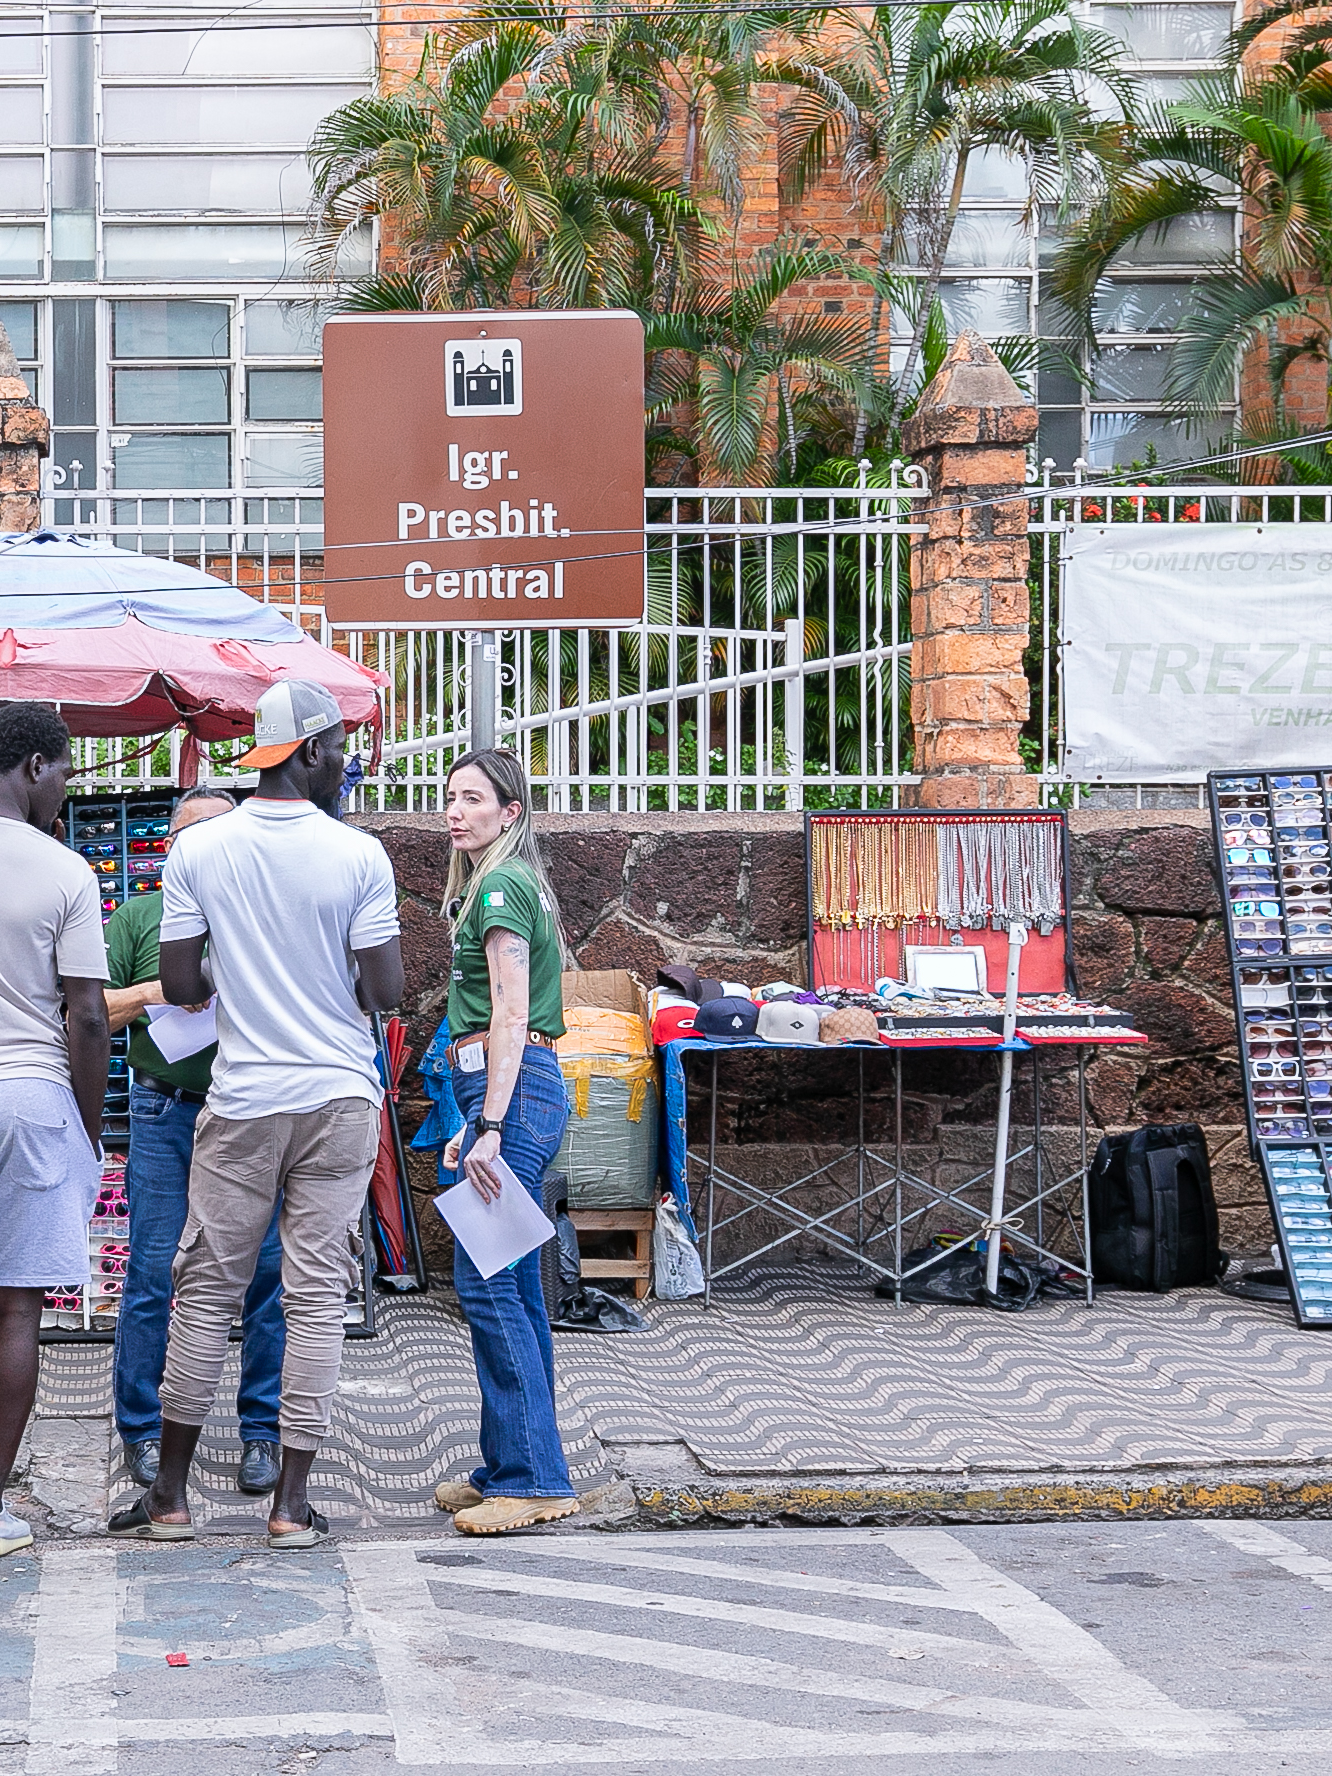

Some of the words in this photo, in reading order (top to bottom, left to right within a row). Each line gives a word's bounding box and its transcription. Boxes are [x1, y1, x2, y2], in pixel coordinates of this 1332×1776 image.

[448, 443, 519, 490] Igr.
[397, 499, 571, 540] Presbit.
[403, 560, 565, 599] Central
[1110, 552, 1258, 572] DOMINGO
